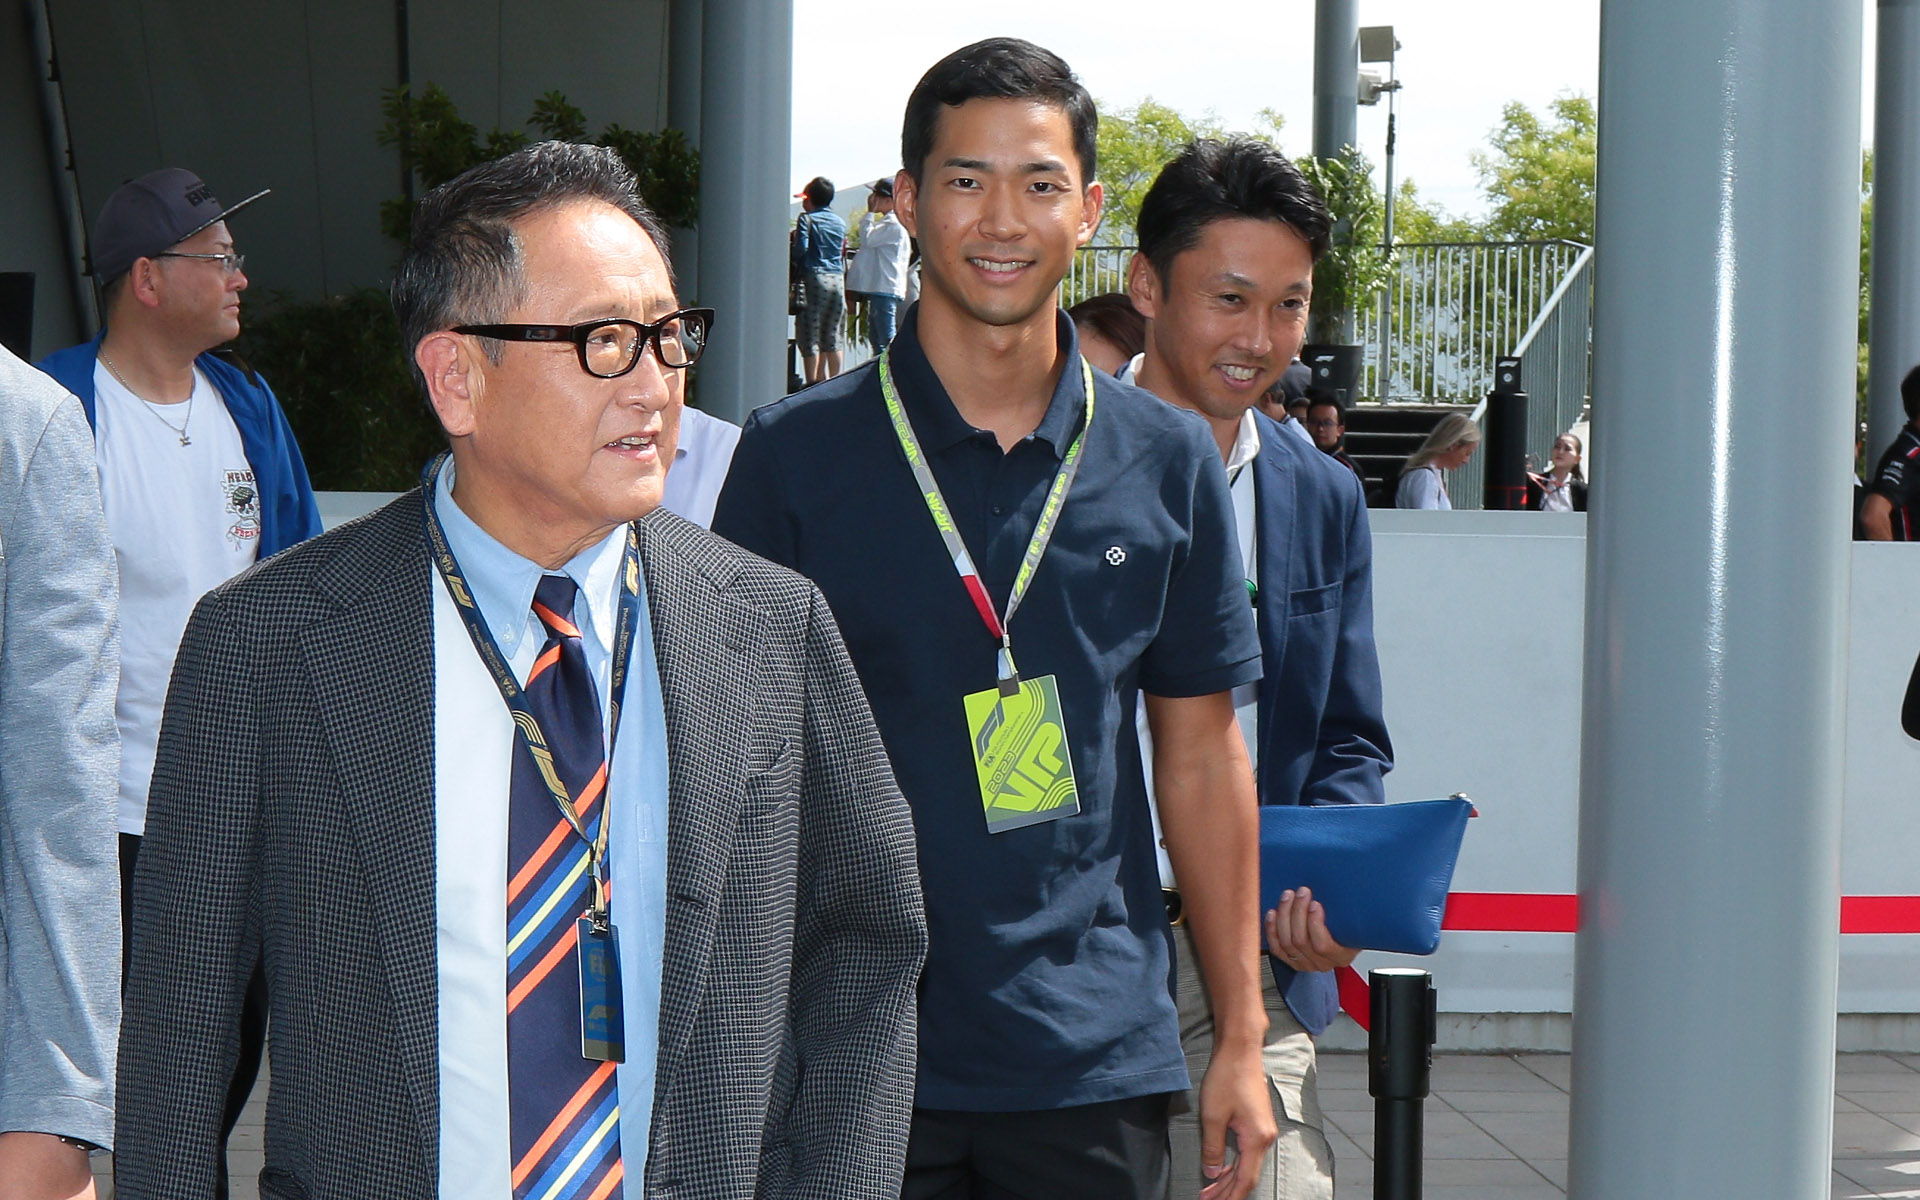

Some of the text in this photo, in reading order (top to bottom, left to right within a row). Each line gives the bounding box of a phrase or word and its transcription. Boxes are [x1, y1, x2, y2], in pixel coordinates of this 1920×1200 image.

[925, 491, 952, 533] JAPAN
[985, 751, 1017, 795] 2023
[991, 721, 1064, 812] VIP
